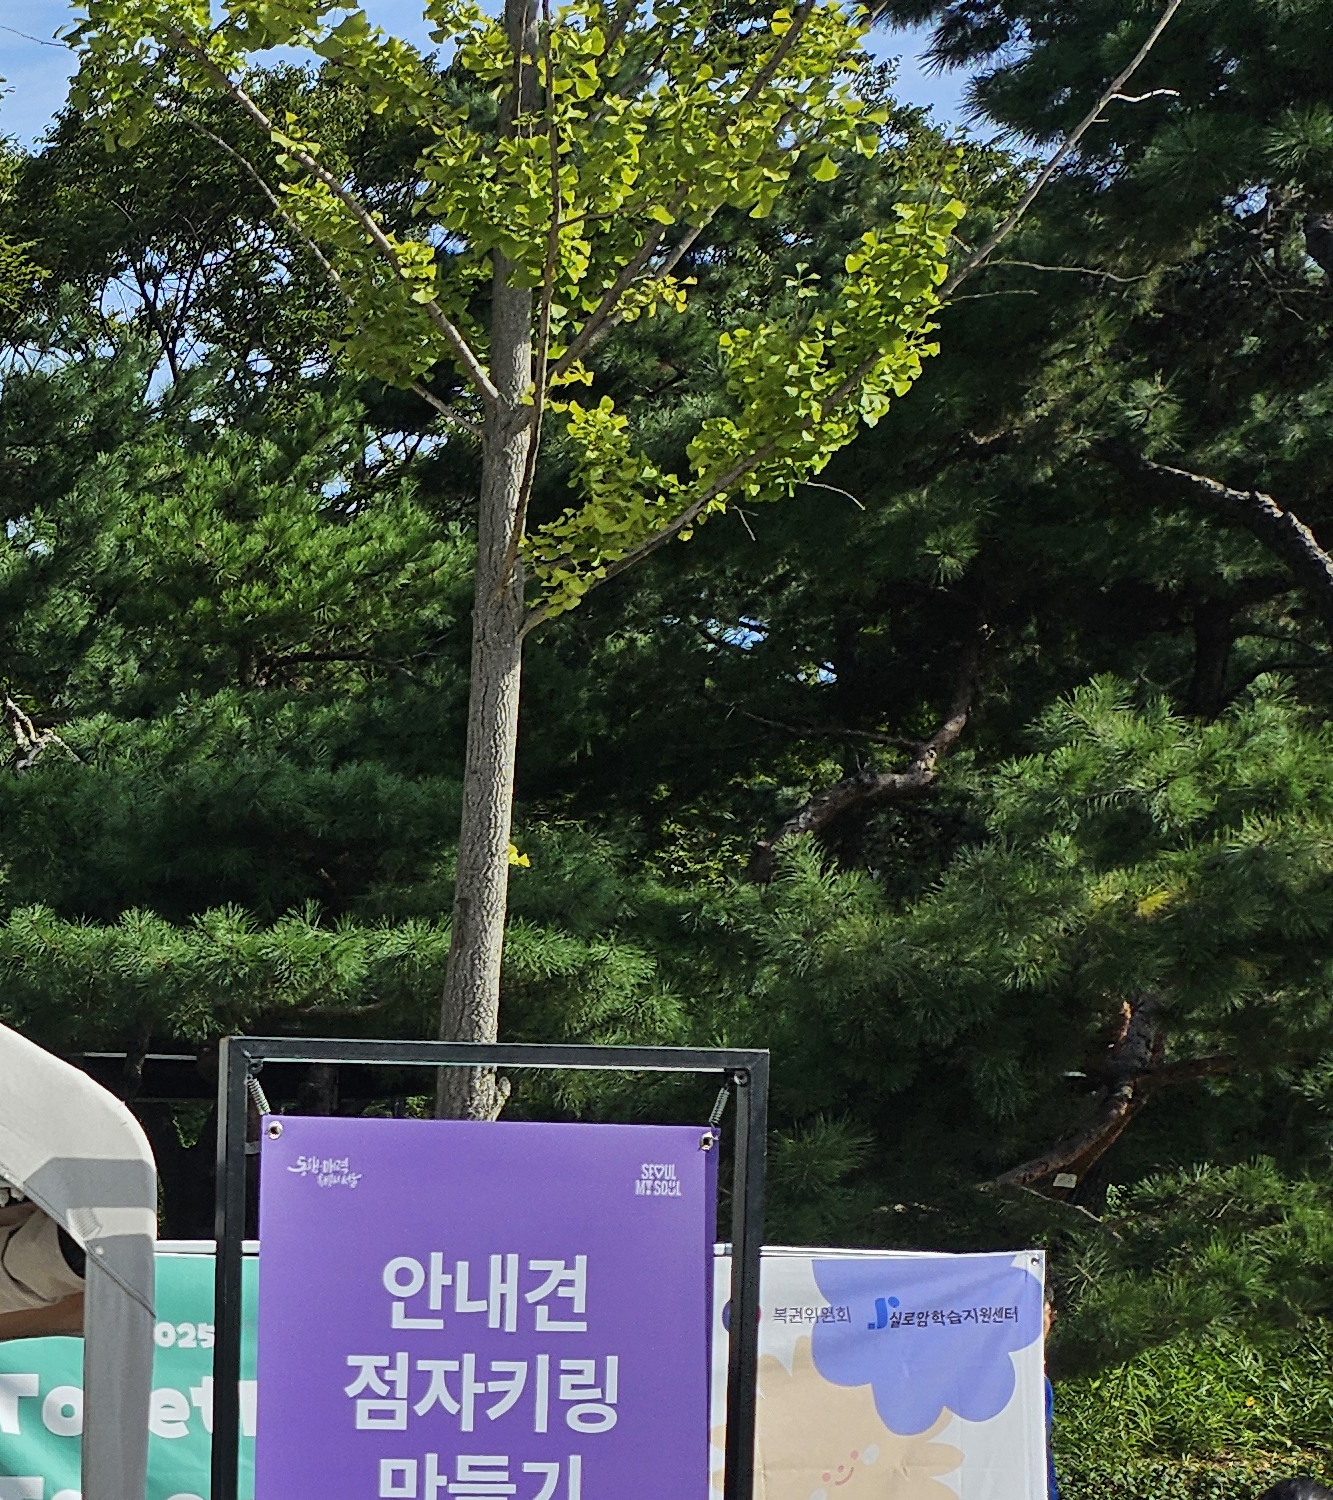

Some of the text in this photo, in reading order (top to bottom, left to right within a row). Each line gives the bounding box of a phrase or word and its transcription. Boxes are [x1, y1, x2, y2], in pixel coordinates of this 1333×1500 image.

[382, 1251, 588, 1332] 안내견
[773, 1305, 1019, 1329] 복권위원회 실로암학습지원센터
[154, 1322, 215, 1348] 025
[344, 1352, 619, 1434] 점자키링
